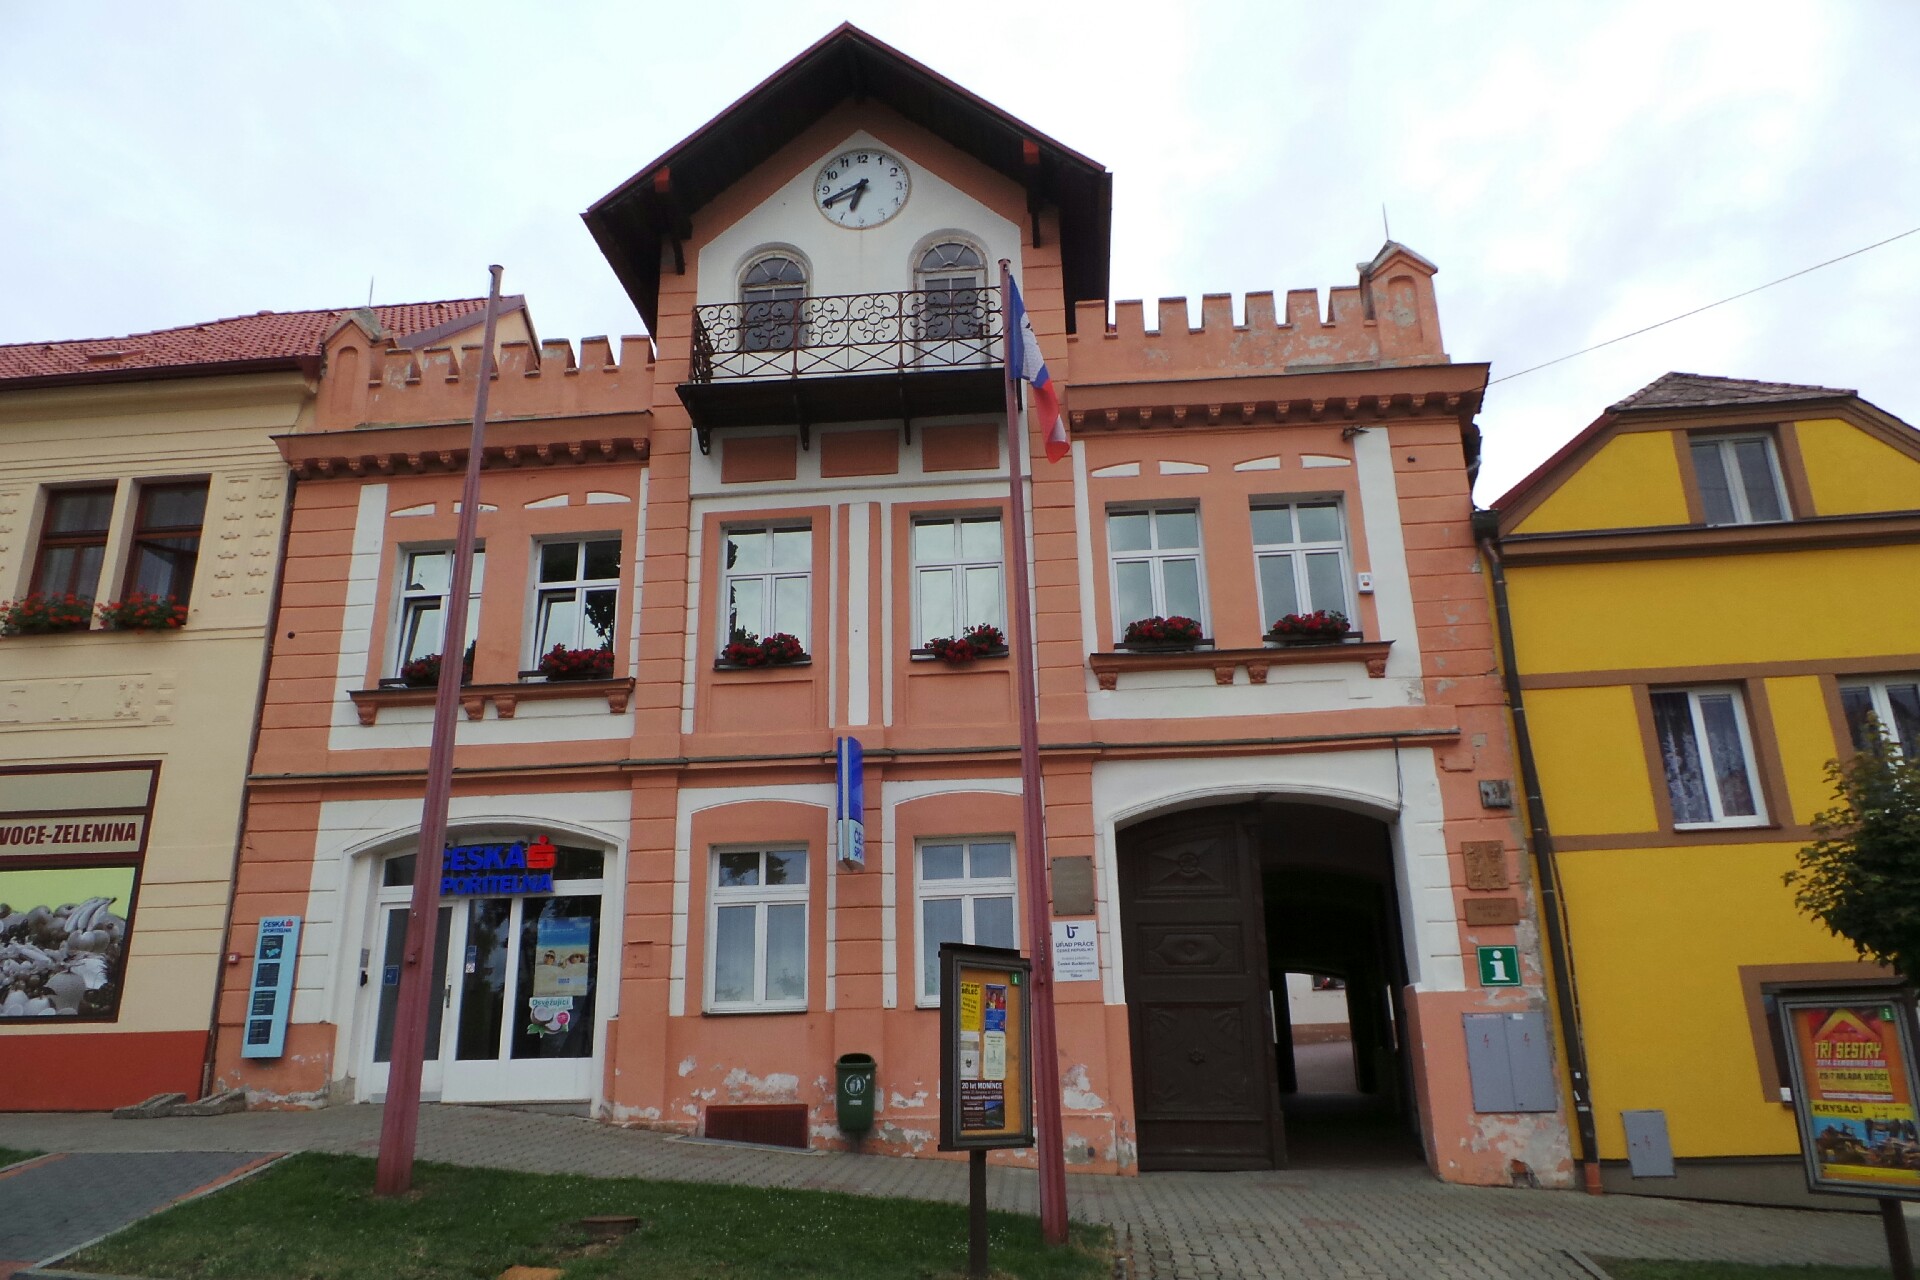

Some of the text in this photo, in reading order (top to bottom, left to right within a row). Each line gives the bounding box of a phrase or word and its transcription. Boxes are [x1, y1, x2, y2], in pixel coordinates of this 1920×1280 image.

[840, 158, 849, 168] 11
[857, 155, 869, 164] 12
[878, 156, 883, 166] 1
[826, 171, 838, 180] 10
[889, 167, 898, 177] 2
[822, 186, 831, 195] 9
[895, 181, 903, 191] 3
[441, 872, 553, 895] POŘITELNA
[1836, 1042, 1881, 1058] SESTRY
